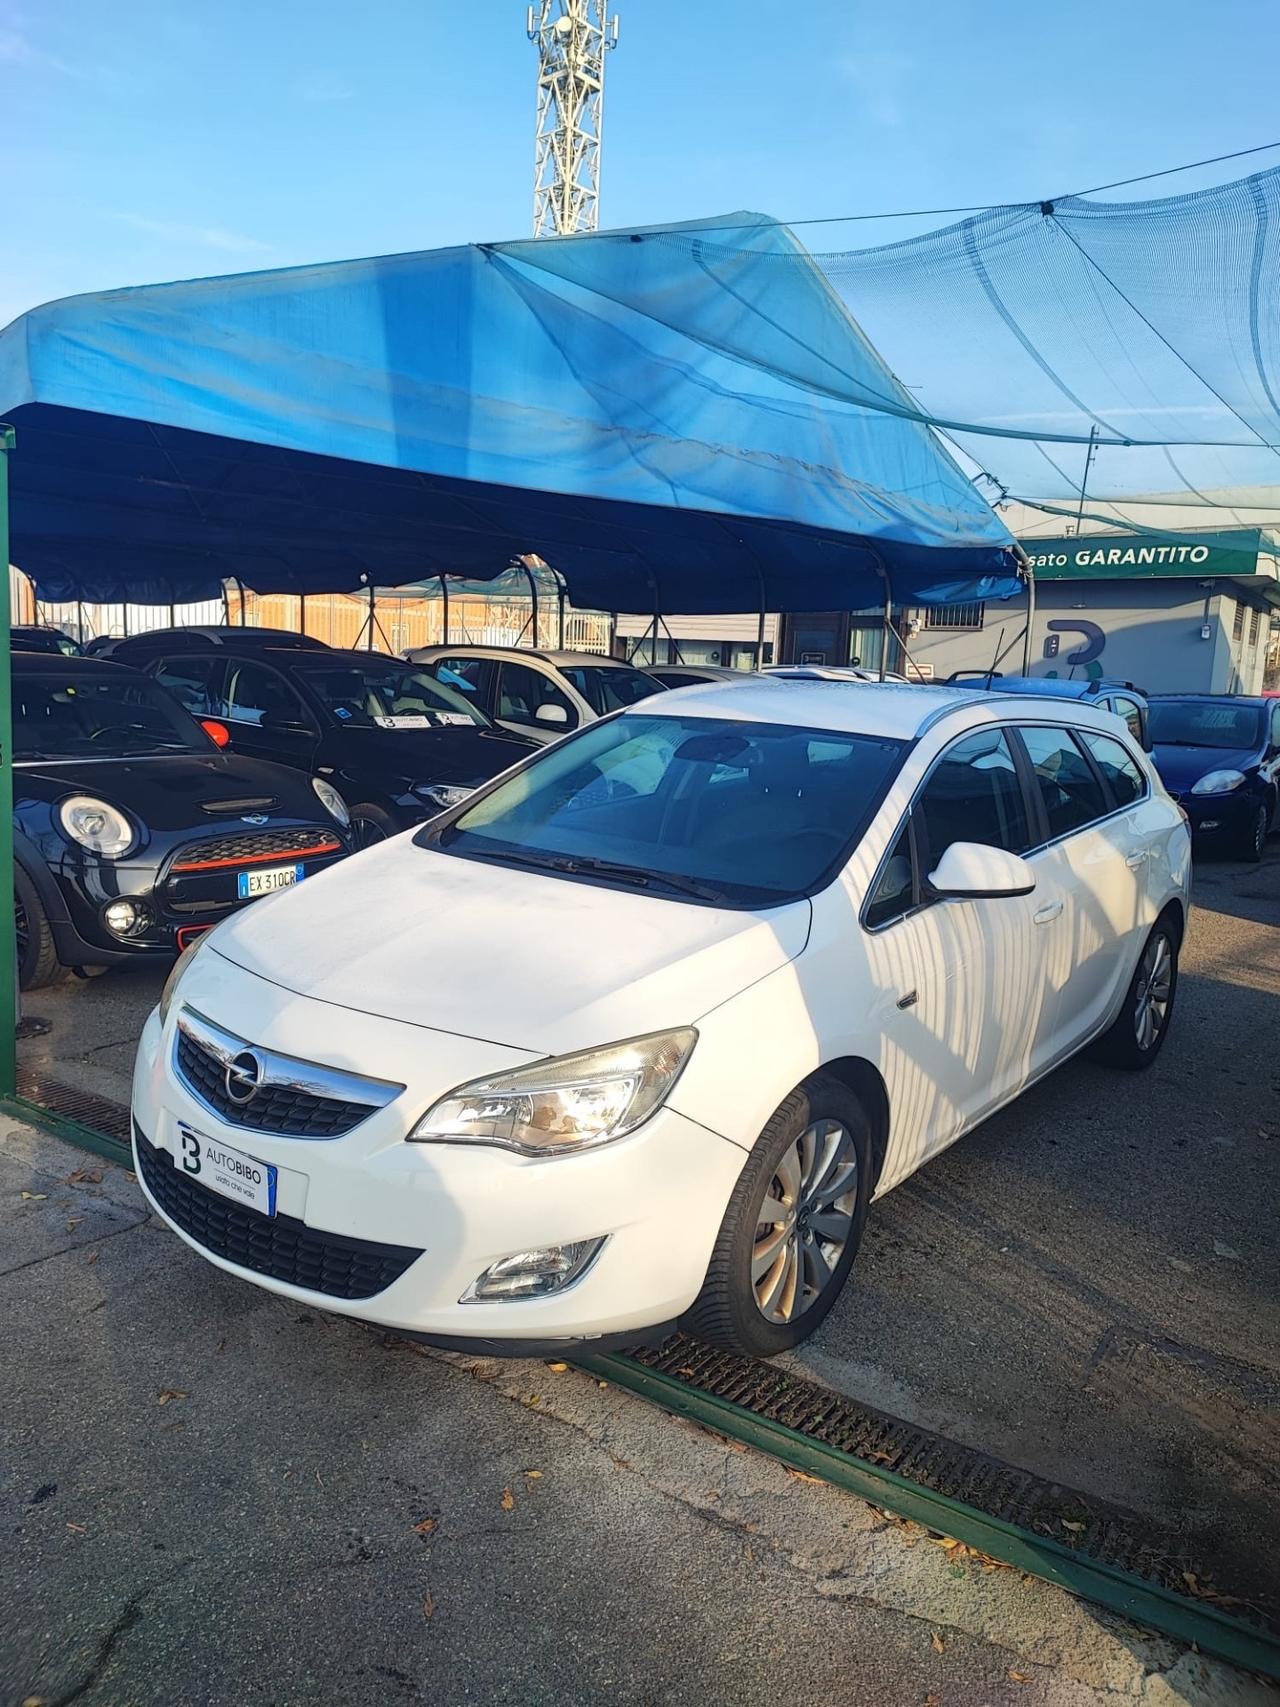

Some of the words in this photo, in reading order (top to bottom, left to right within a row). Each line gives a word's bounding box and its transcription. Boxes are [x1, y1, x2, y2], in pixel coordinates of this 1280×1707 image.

[1028, 553, 1067, 566] sato
[1075, 545, 1209, 566] GARANTITO
[250, 875, 262, 892] EX
[265, 870, 296, 888] 310CR
[206, 1147, 261, 1184] AUTOBIBO
